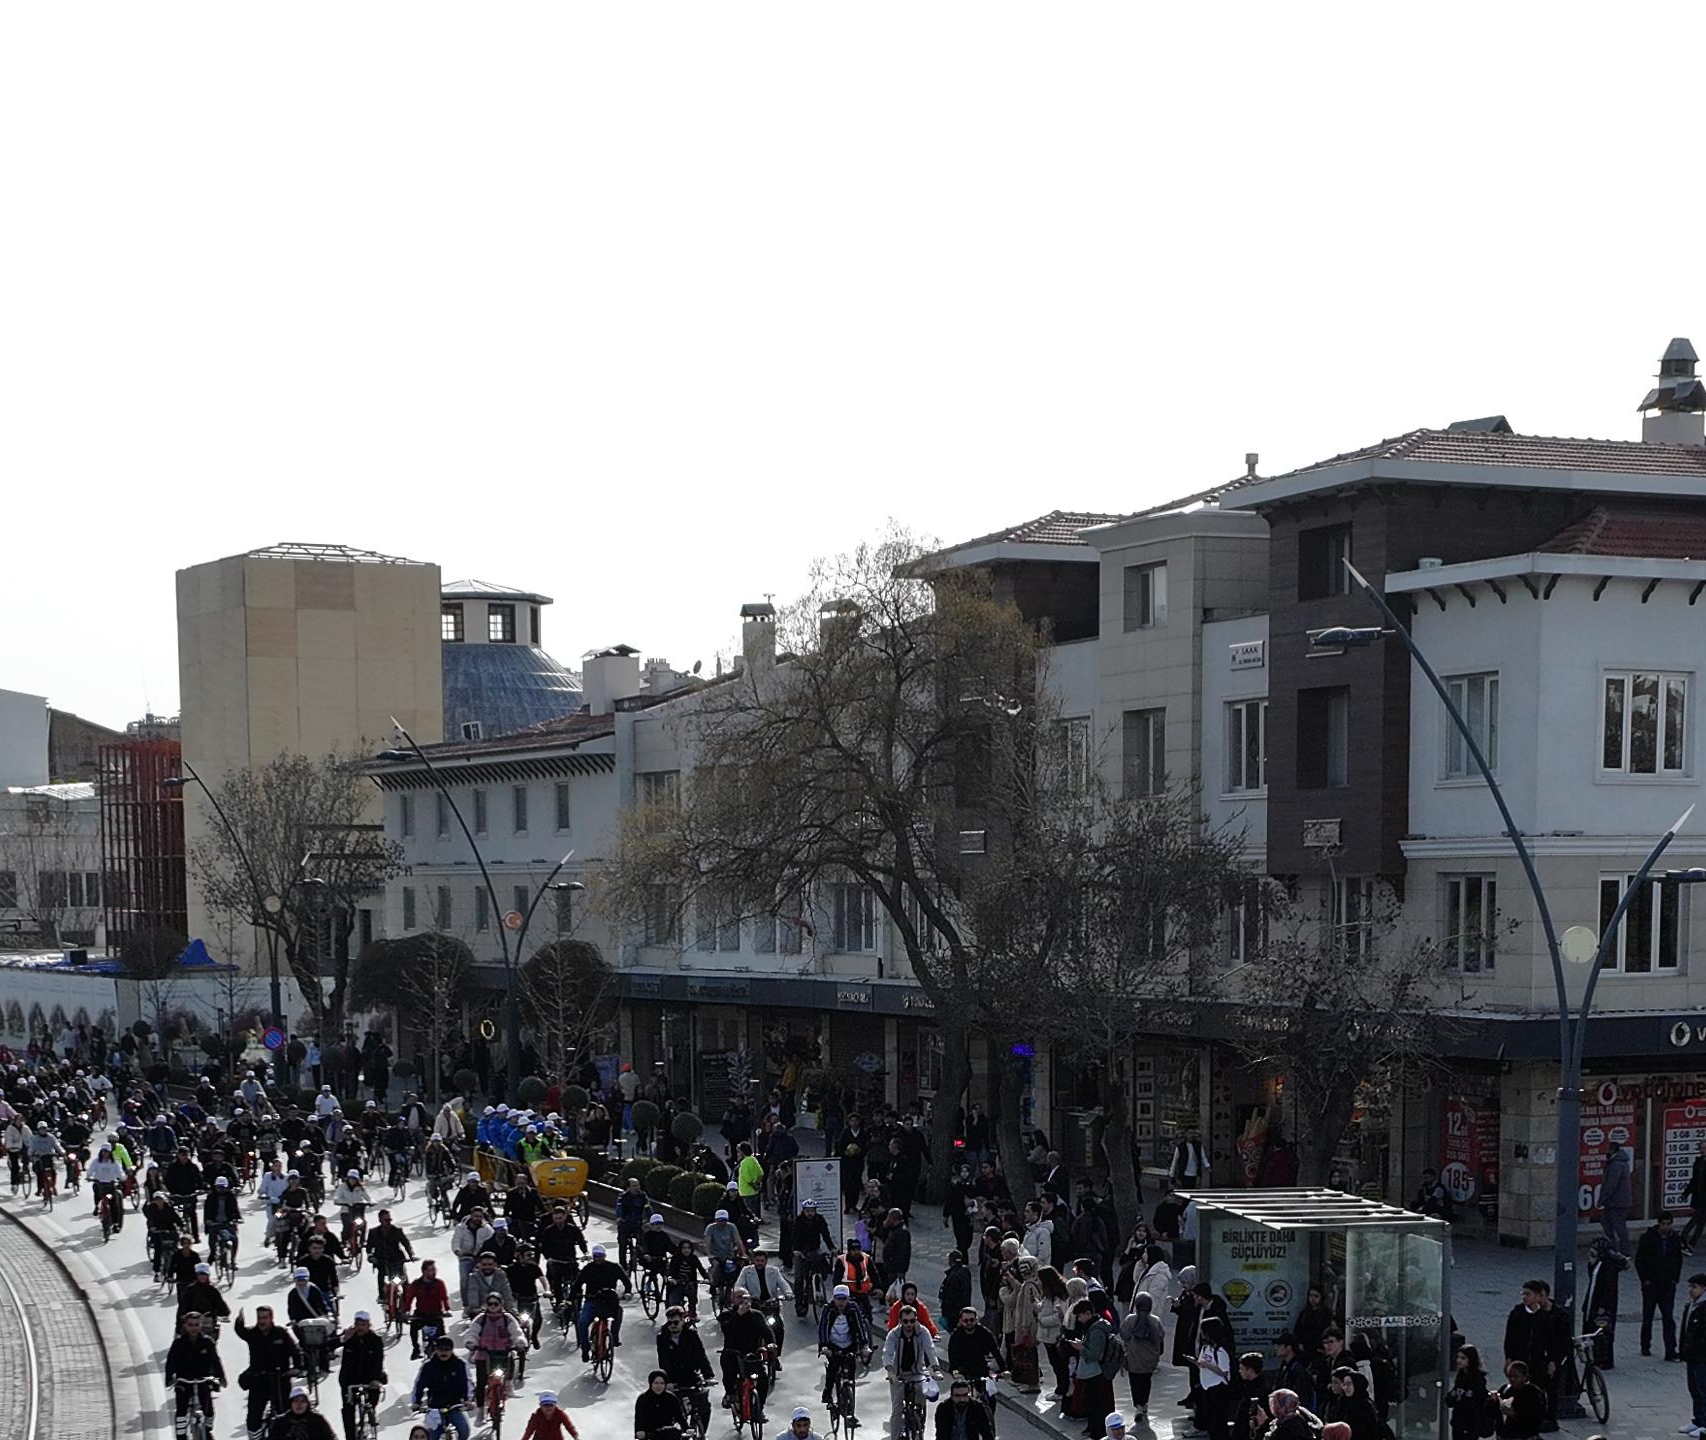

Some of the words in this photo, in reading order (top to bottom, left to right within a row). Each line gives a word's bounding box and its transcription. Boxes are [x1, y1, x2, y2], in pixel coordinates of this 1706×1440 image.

[1446, 1167, 1469, 1191] 185
[1222, 1228, 1267, 1243] BİRLİKTE
[1269, 1230, 1296, 1243] DAHA
[1231, 1244, 1287, 1262] GÜÇLÜYÜZ!
